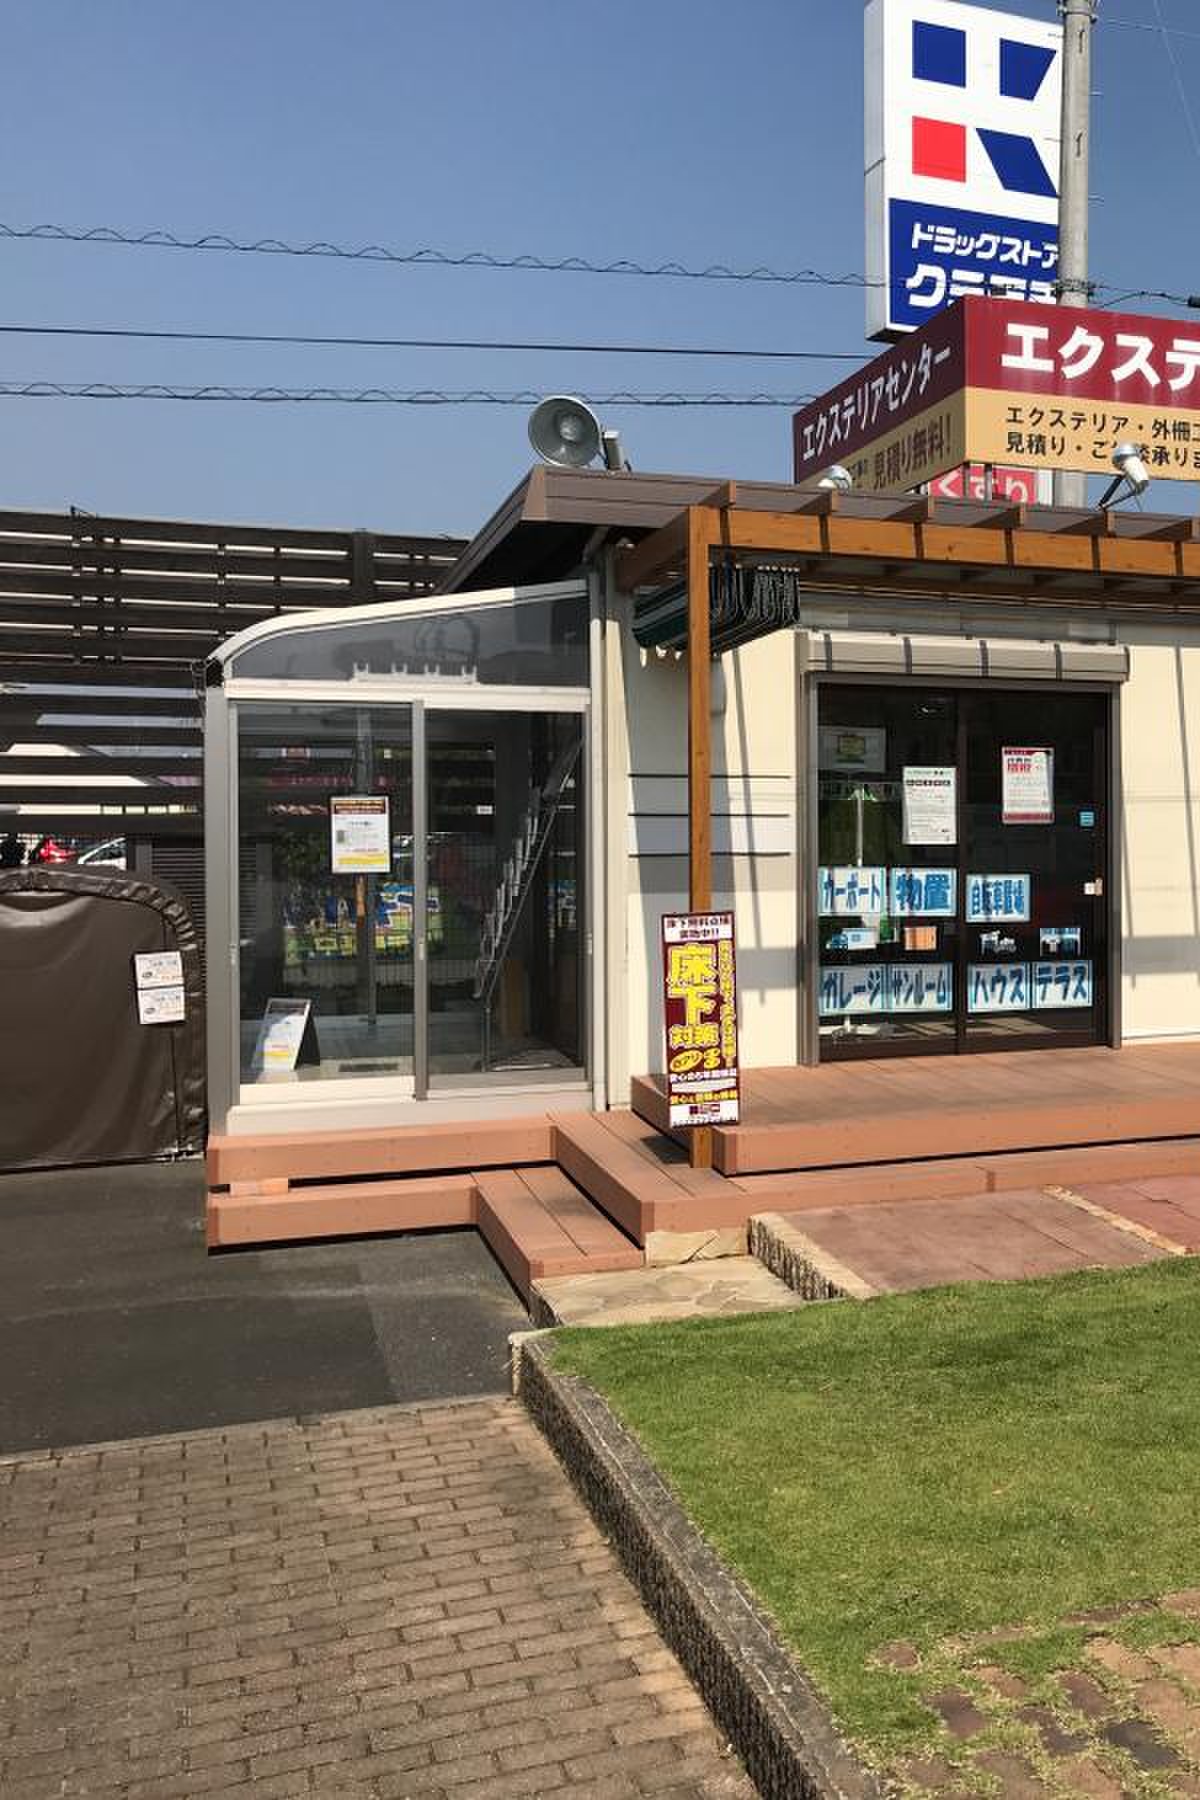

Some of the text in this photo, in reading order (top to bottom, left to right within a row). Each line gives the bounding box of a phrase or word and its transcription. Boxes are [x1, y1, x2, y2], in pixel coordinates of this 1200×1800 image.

[802, 342, 951, 461] エクステリアセンター
[896, 873, 950, 911] 物置
[974, 967, 1025, 1005] ハウス
[1037, 965, 1087, 1001] テラス
